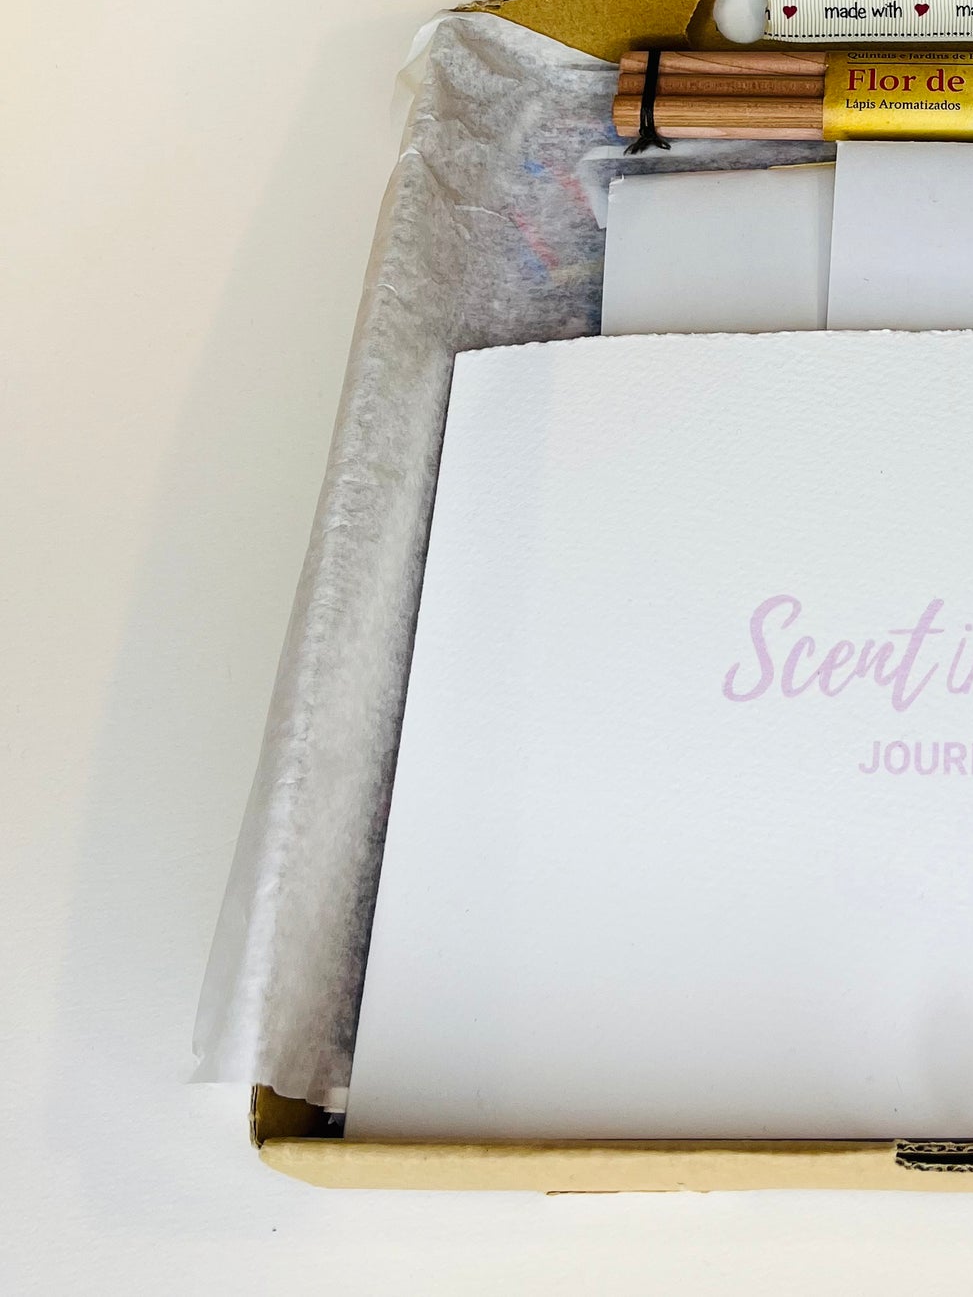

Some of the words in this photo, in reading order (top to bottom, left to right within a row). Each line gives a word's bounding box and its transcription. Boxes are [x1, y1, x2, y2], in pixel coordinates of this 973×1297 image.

[824, 2, 867, 20] made
[872, 1, 903, 19] with
[846, 68, 917, 92] Flor
[926, 68, 965, 93] de
[845, 99, 876, 112] Lápis
[879, 100, 961, 111] Aromatizados
